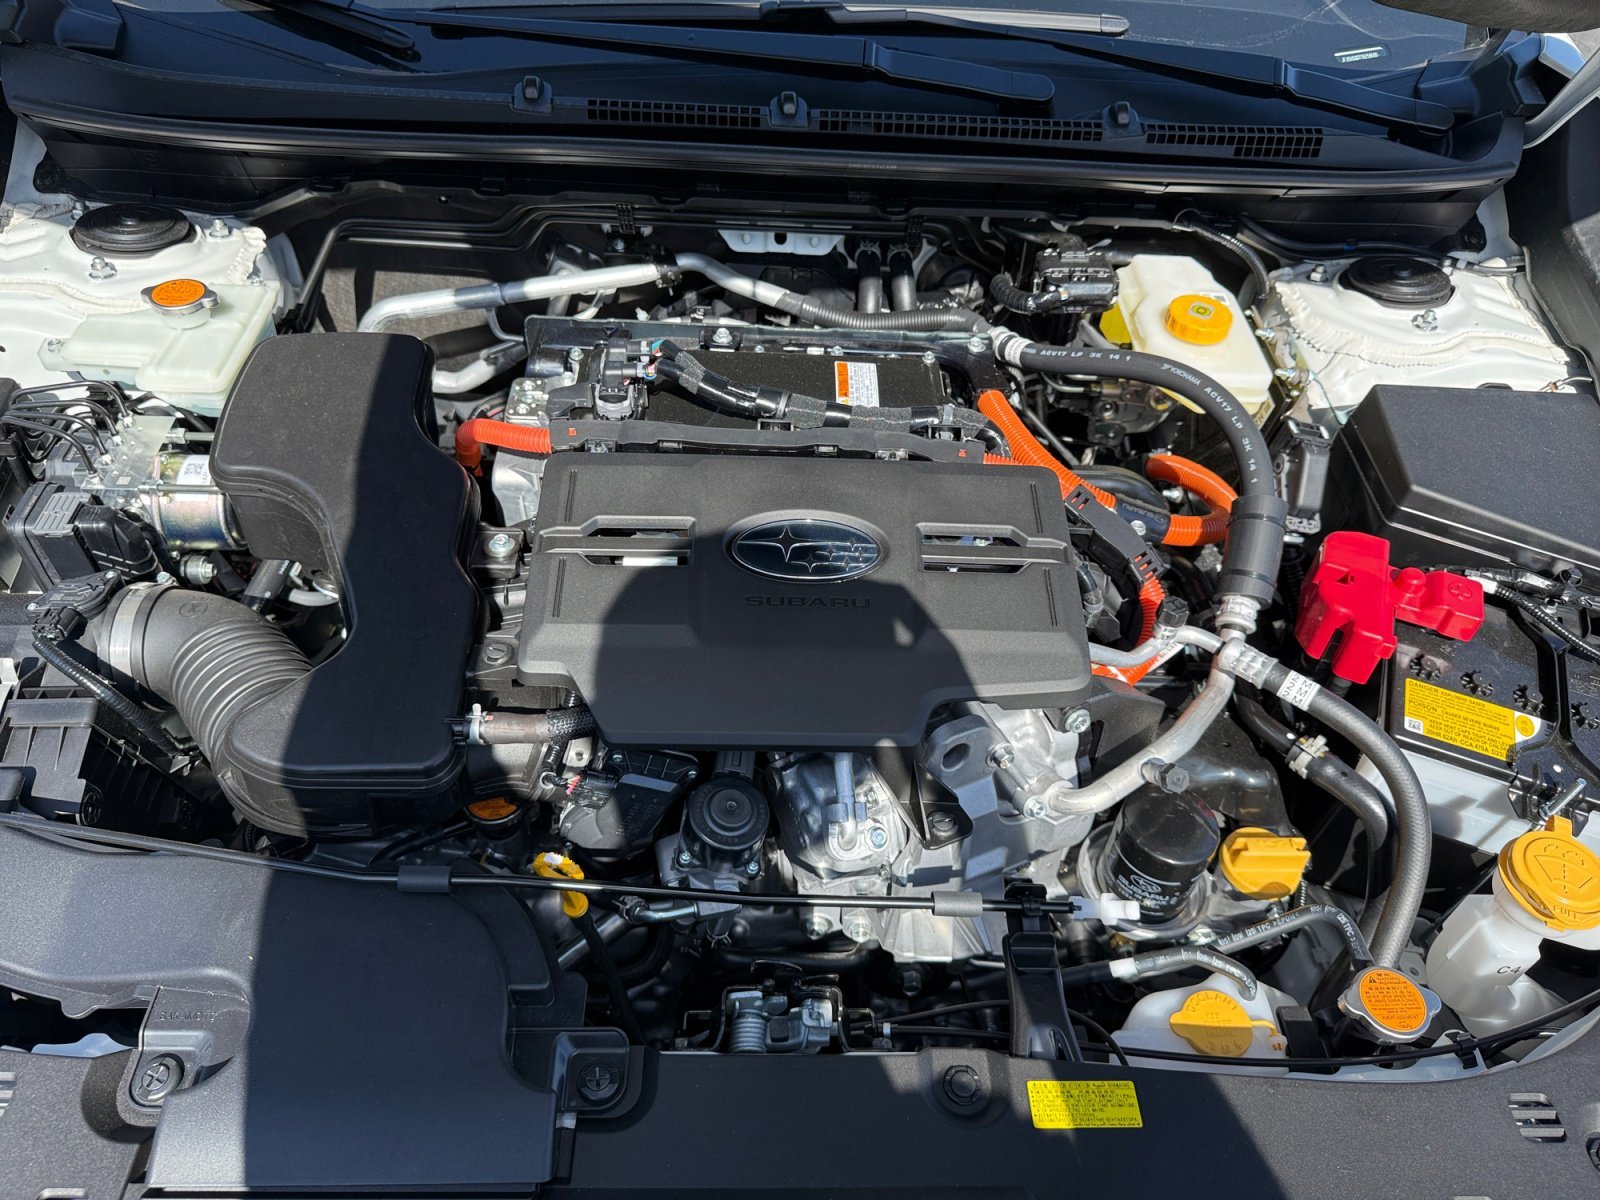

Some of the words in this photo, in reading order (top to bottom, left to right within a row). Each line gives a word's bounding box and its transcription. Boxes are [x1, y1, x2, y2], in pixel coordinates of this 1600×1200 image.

[1040, 349, 1066, 357] ACV17
[1204, 386, 1232, 412] ACV17
[1231, 415, 1244, 429] LP
[1247, 458, 1257, 471] 14
[743, 595, 871, 608] SUBARU
[1291, 675, 1300, 683] 2
[1301, 680, 1312, 689] M
[1408, 680, 1439, 694] DANGER
[1286, 682, 1295, 691] 2
[1296, 687, 1308, 698] M
[1291, 695, 1303, 705] M
[1408, 699, 1438, 713] POISON
[1460, 739, 1474, 748] CCA
[1257, 921, 1271, 933] TPC
[1185, 991, 1239, 1013] COOLANT
